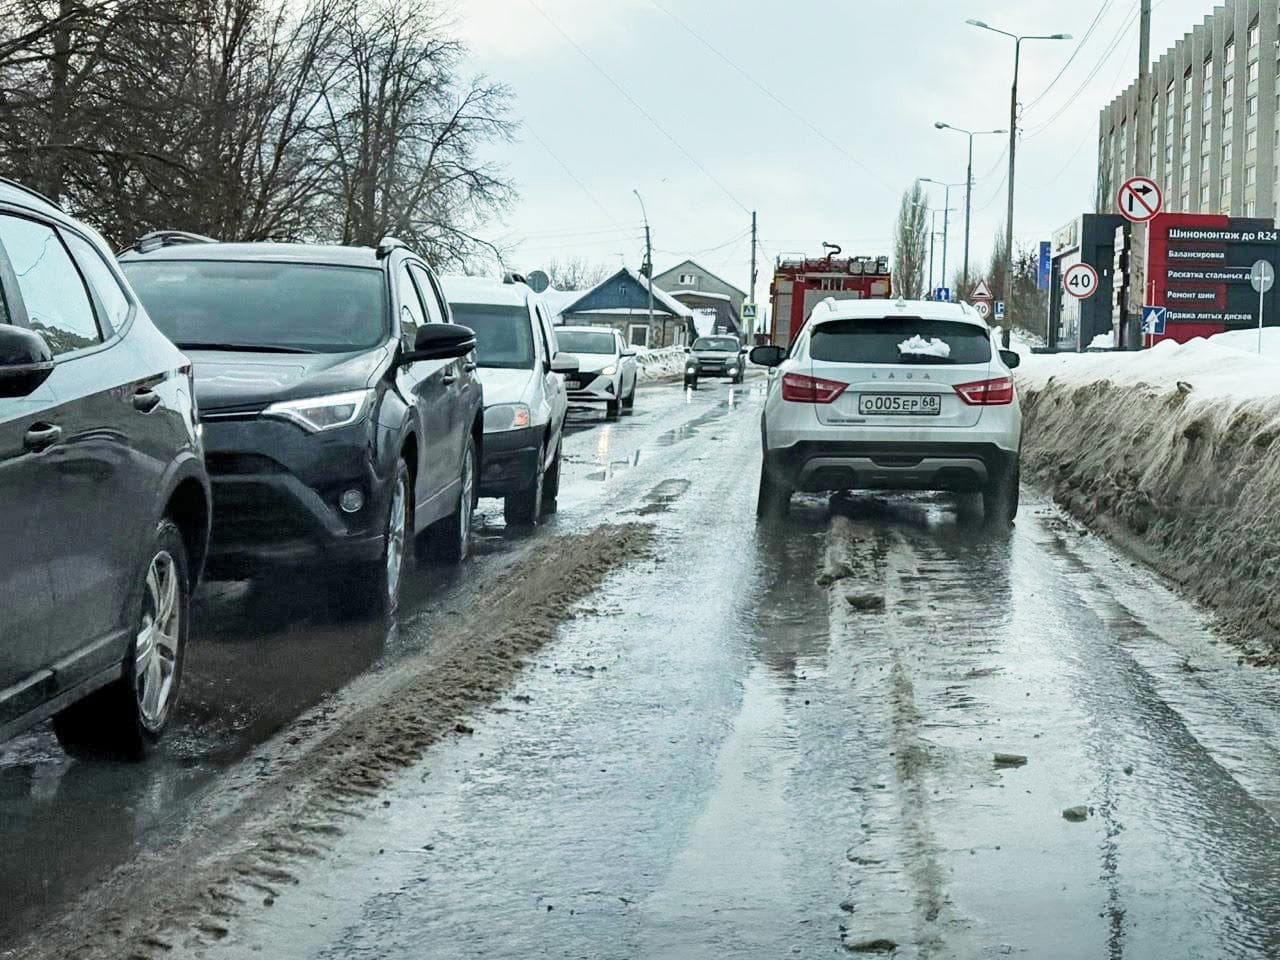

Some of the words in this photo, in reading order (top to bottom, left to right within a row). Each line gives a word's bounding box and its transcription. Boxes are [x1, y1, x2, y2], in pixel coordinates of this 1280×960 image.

[1169, 229, 1239, 240] Шиномонтаж
[1258, 231, 1278, 240] R24
[1168, 250, 1225, 259] Балансировка
[1167, 270, 1203, 278] Раскатка
[1069, 274, 1091, 288] 40
[1167, 311, 1196, 319] Правка
[872, 372, 930, 380] LADA
